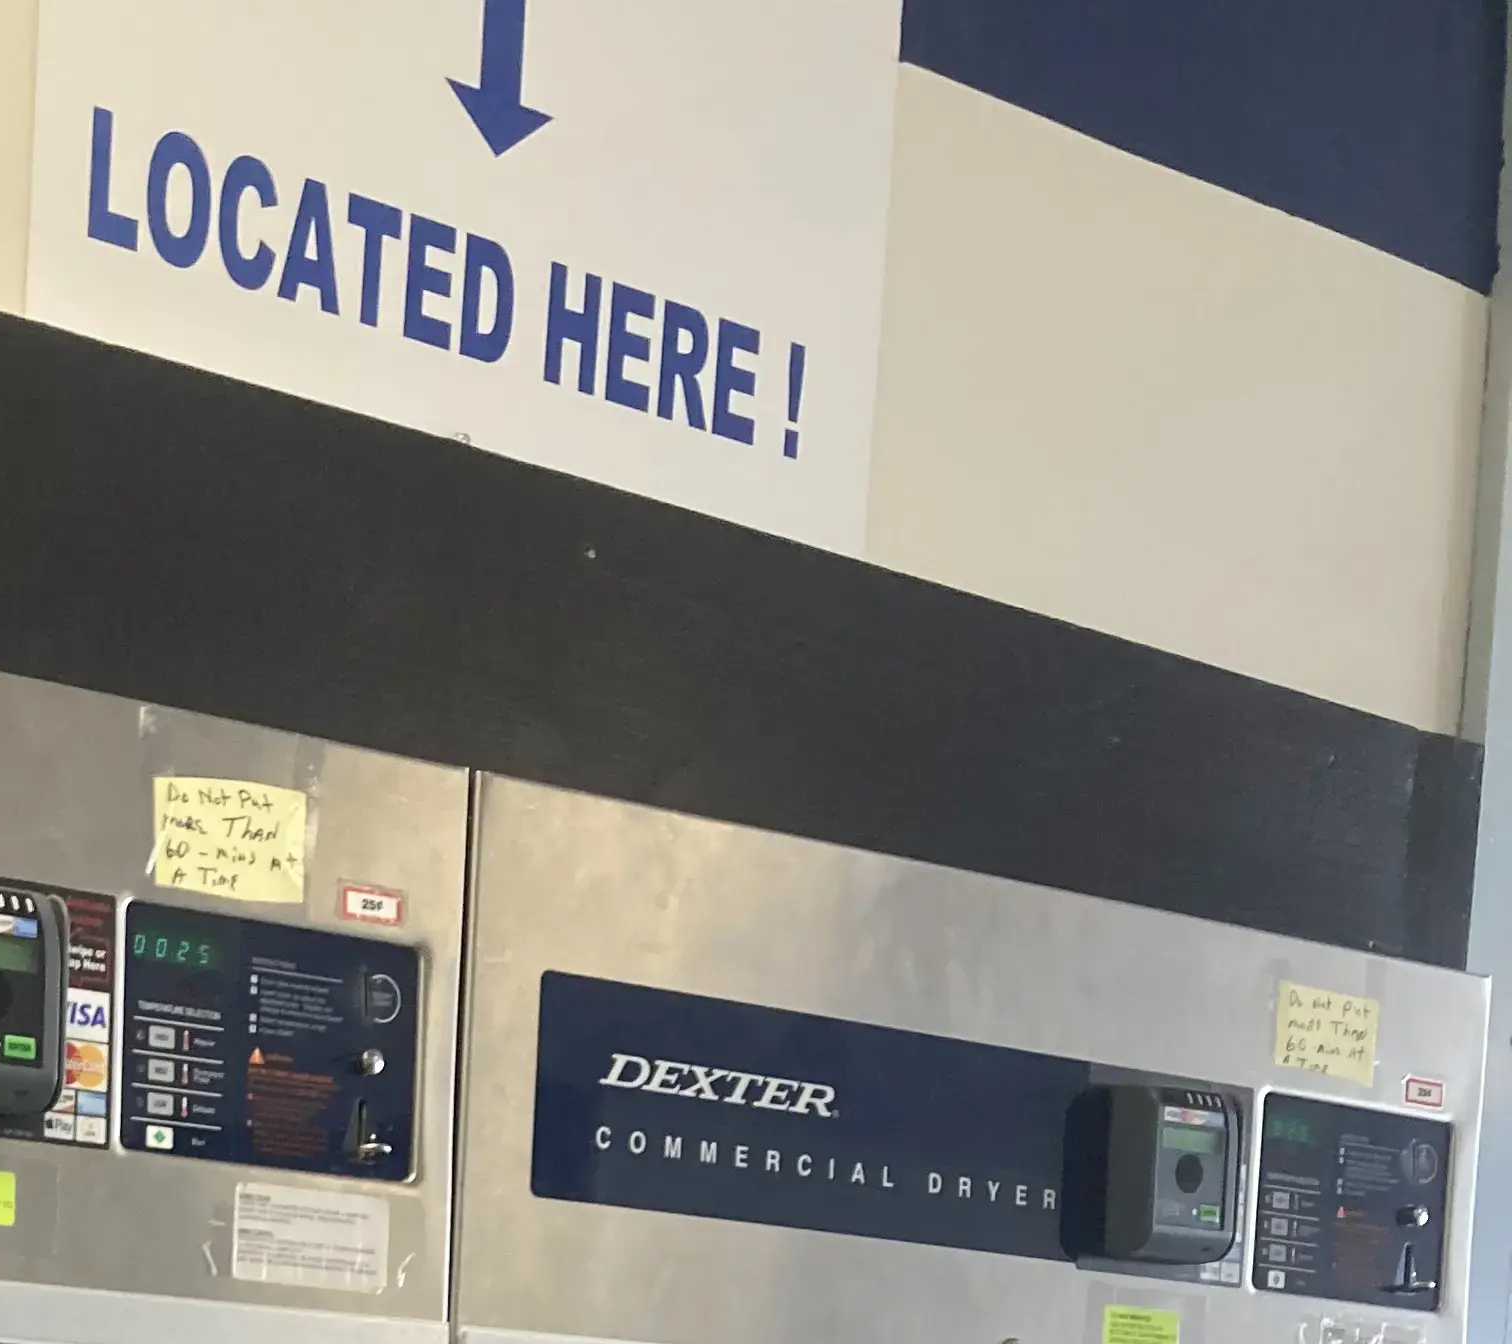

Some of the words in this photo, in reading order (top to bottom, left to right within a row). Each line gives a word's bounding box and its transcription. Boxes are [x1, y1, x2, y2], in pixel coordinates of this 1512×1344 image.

[88, 106, 515, 364] LOCATED
[543, 261, 760, 446] HERE
[167, 781, 189, 803] Do
[198, 787, 231, 807] Not
[238, 789, 274, 813] Put
[166, 839, 189, 859] 60
[67, 1001, 107, 1028] ISA
[598, 1053, 837, 1118] DEXTER
[595, 1126, 895, 1188] COMMERCIAL
[928, 1172, 1057, 1210] DRYER
